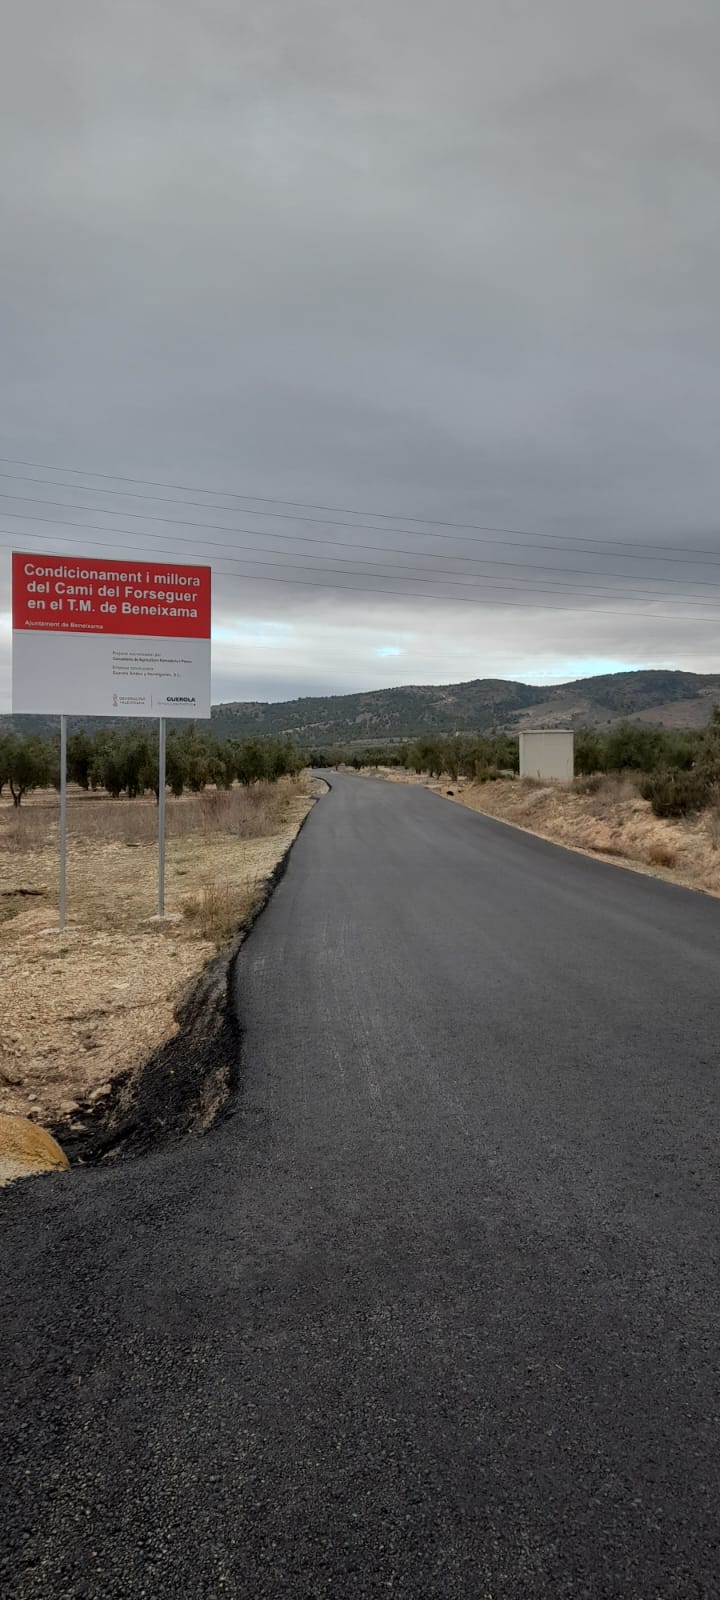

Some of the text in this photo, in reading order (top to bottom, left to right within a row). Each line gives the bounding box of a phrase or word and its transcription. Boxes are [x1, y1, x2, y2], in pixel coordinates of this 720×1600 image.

[24, 563, 200, 586] Condicionament i millora
[27, 581, 50, 593] del
[98, 584, 120, 597] del
[125, 586, 198, 602] Forseguer
[27, 599, 198, 618] en el T.M. de Beneixama
[25, 619, 60, 627] Ajuntament
